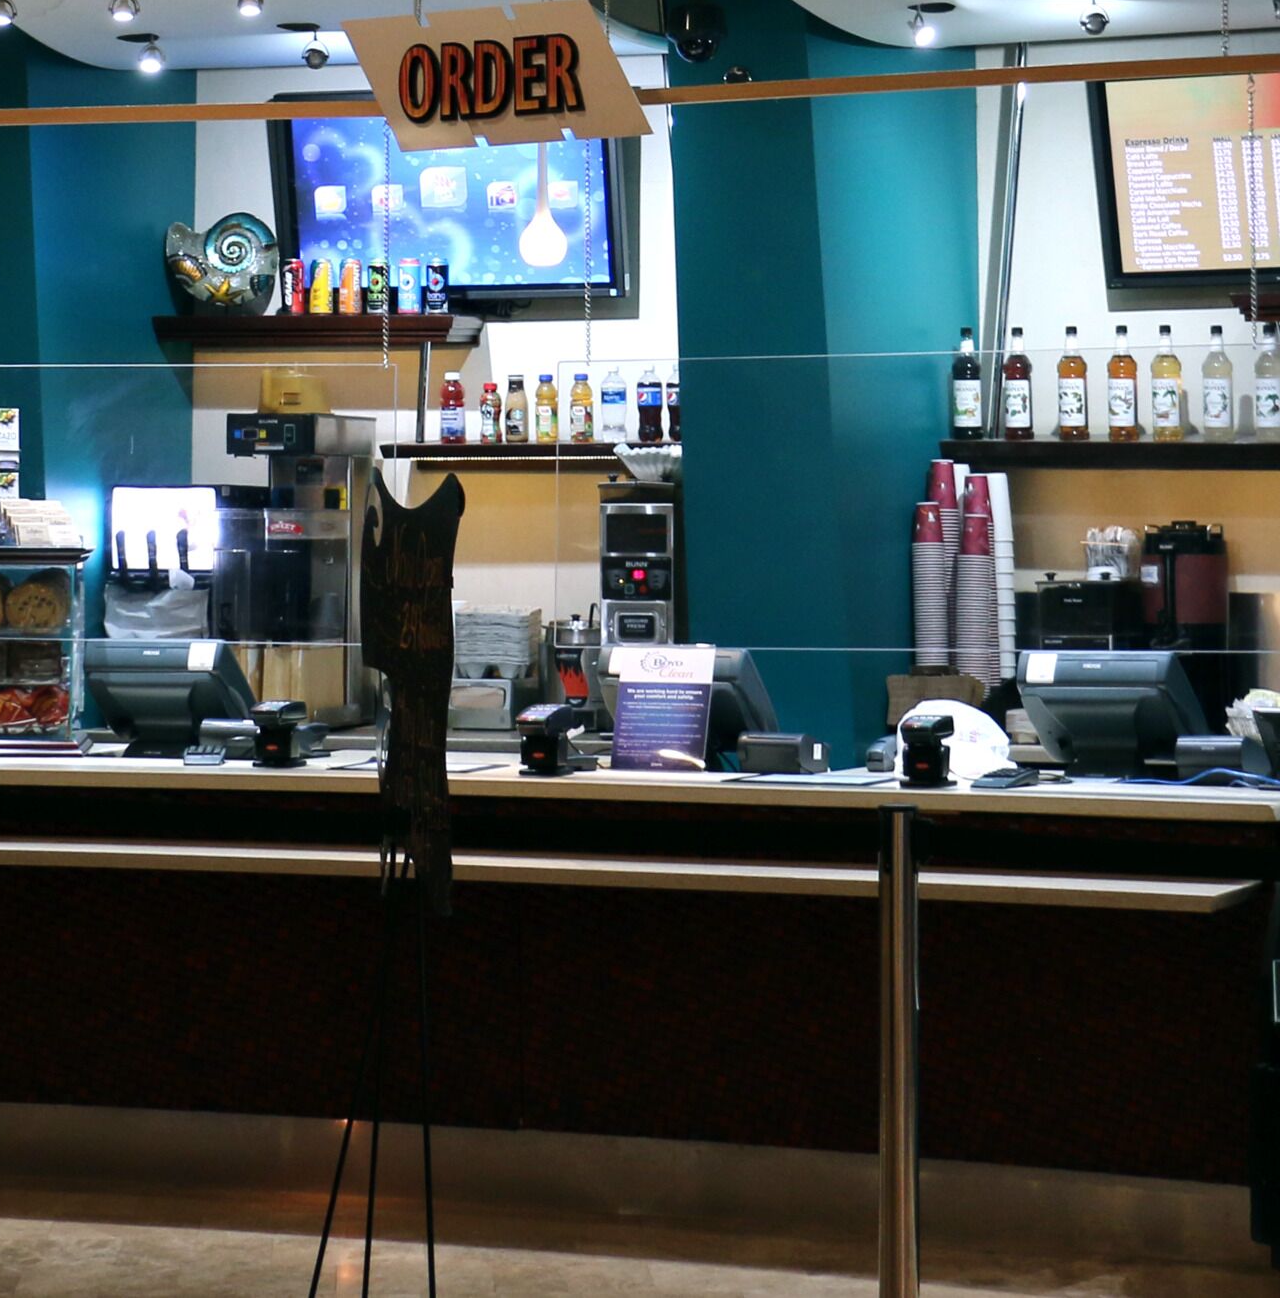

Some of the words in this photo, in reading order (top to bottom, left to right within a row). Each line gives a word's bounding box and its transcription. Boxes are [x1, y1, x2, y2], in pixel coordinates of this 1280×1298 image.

[398, 33, 586, 124] ORDER
[1125, 138, 1161, 147] Espresso
[1163, 136, 1189, 144] Drinks
[658, 668, 694, 679] Clean
